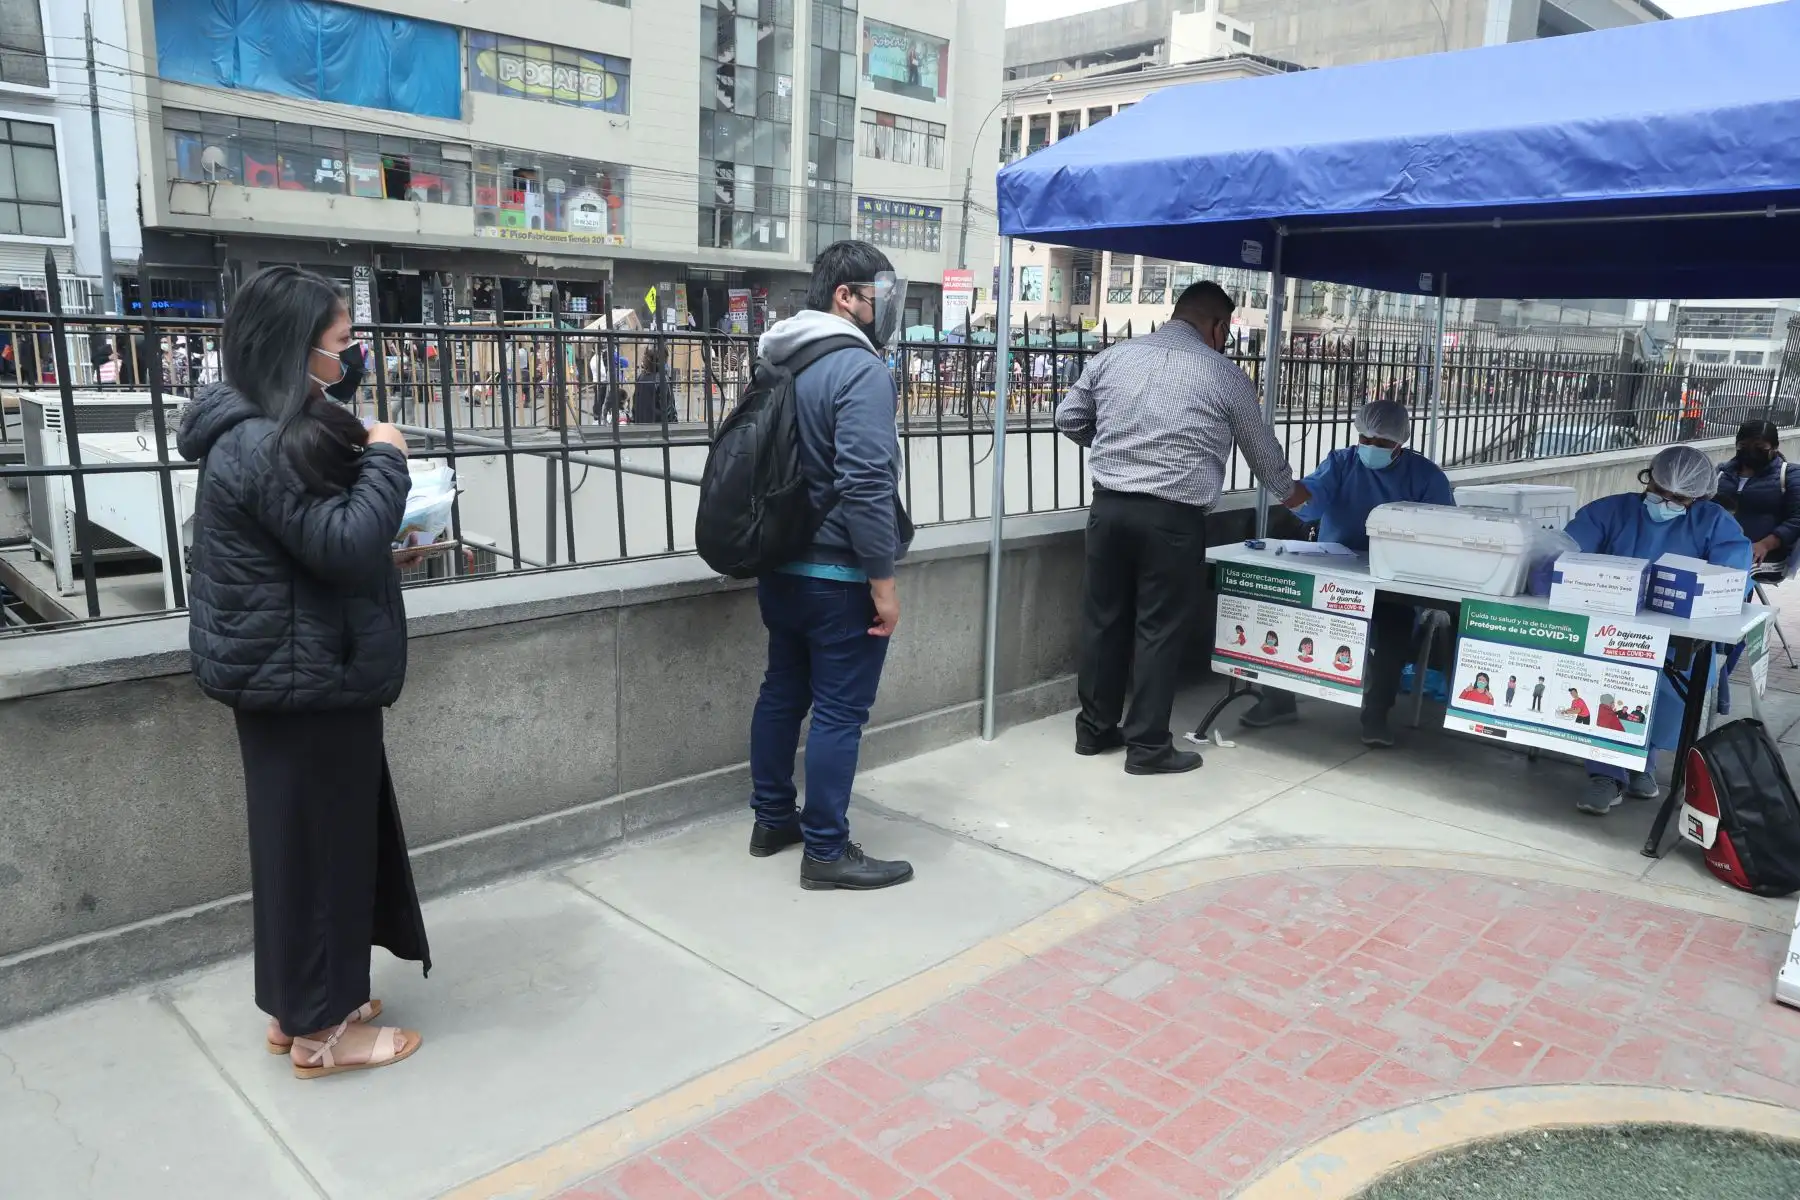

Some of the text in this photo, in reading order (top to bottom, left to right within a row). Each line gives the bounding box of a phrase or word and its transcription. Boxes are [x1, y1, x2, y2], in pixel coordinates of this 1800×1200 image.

[354, 267, 370, 278] 612
[1226, 569, 1296, 587] Usa correctamente
[1226, 577, 1237, 585] las
[1239, 579, 1254, 588] dos
[1255, 582, 1301, 596] mascarillas
[1319, 583, 1335, 593] NO
[1470, 611, 1489, 620] Cuida
[1469, 620, 1504, 632] Protégete
[1528, 628, 1580, 643] COVID-19
[1595, 625, 1653, 640] NO bajemos
[1617, 640, 1650, 650] guardia
